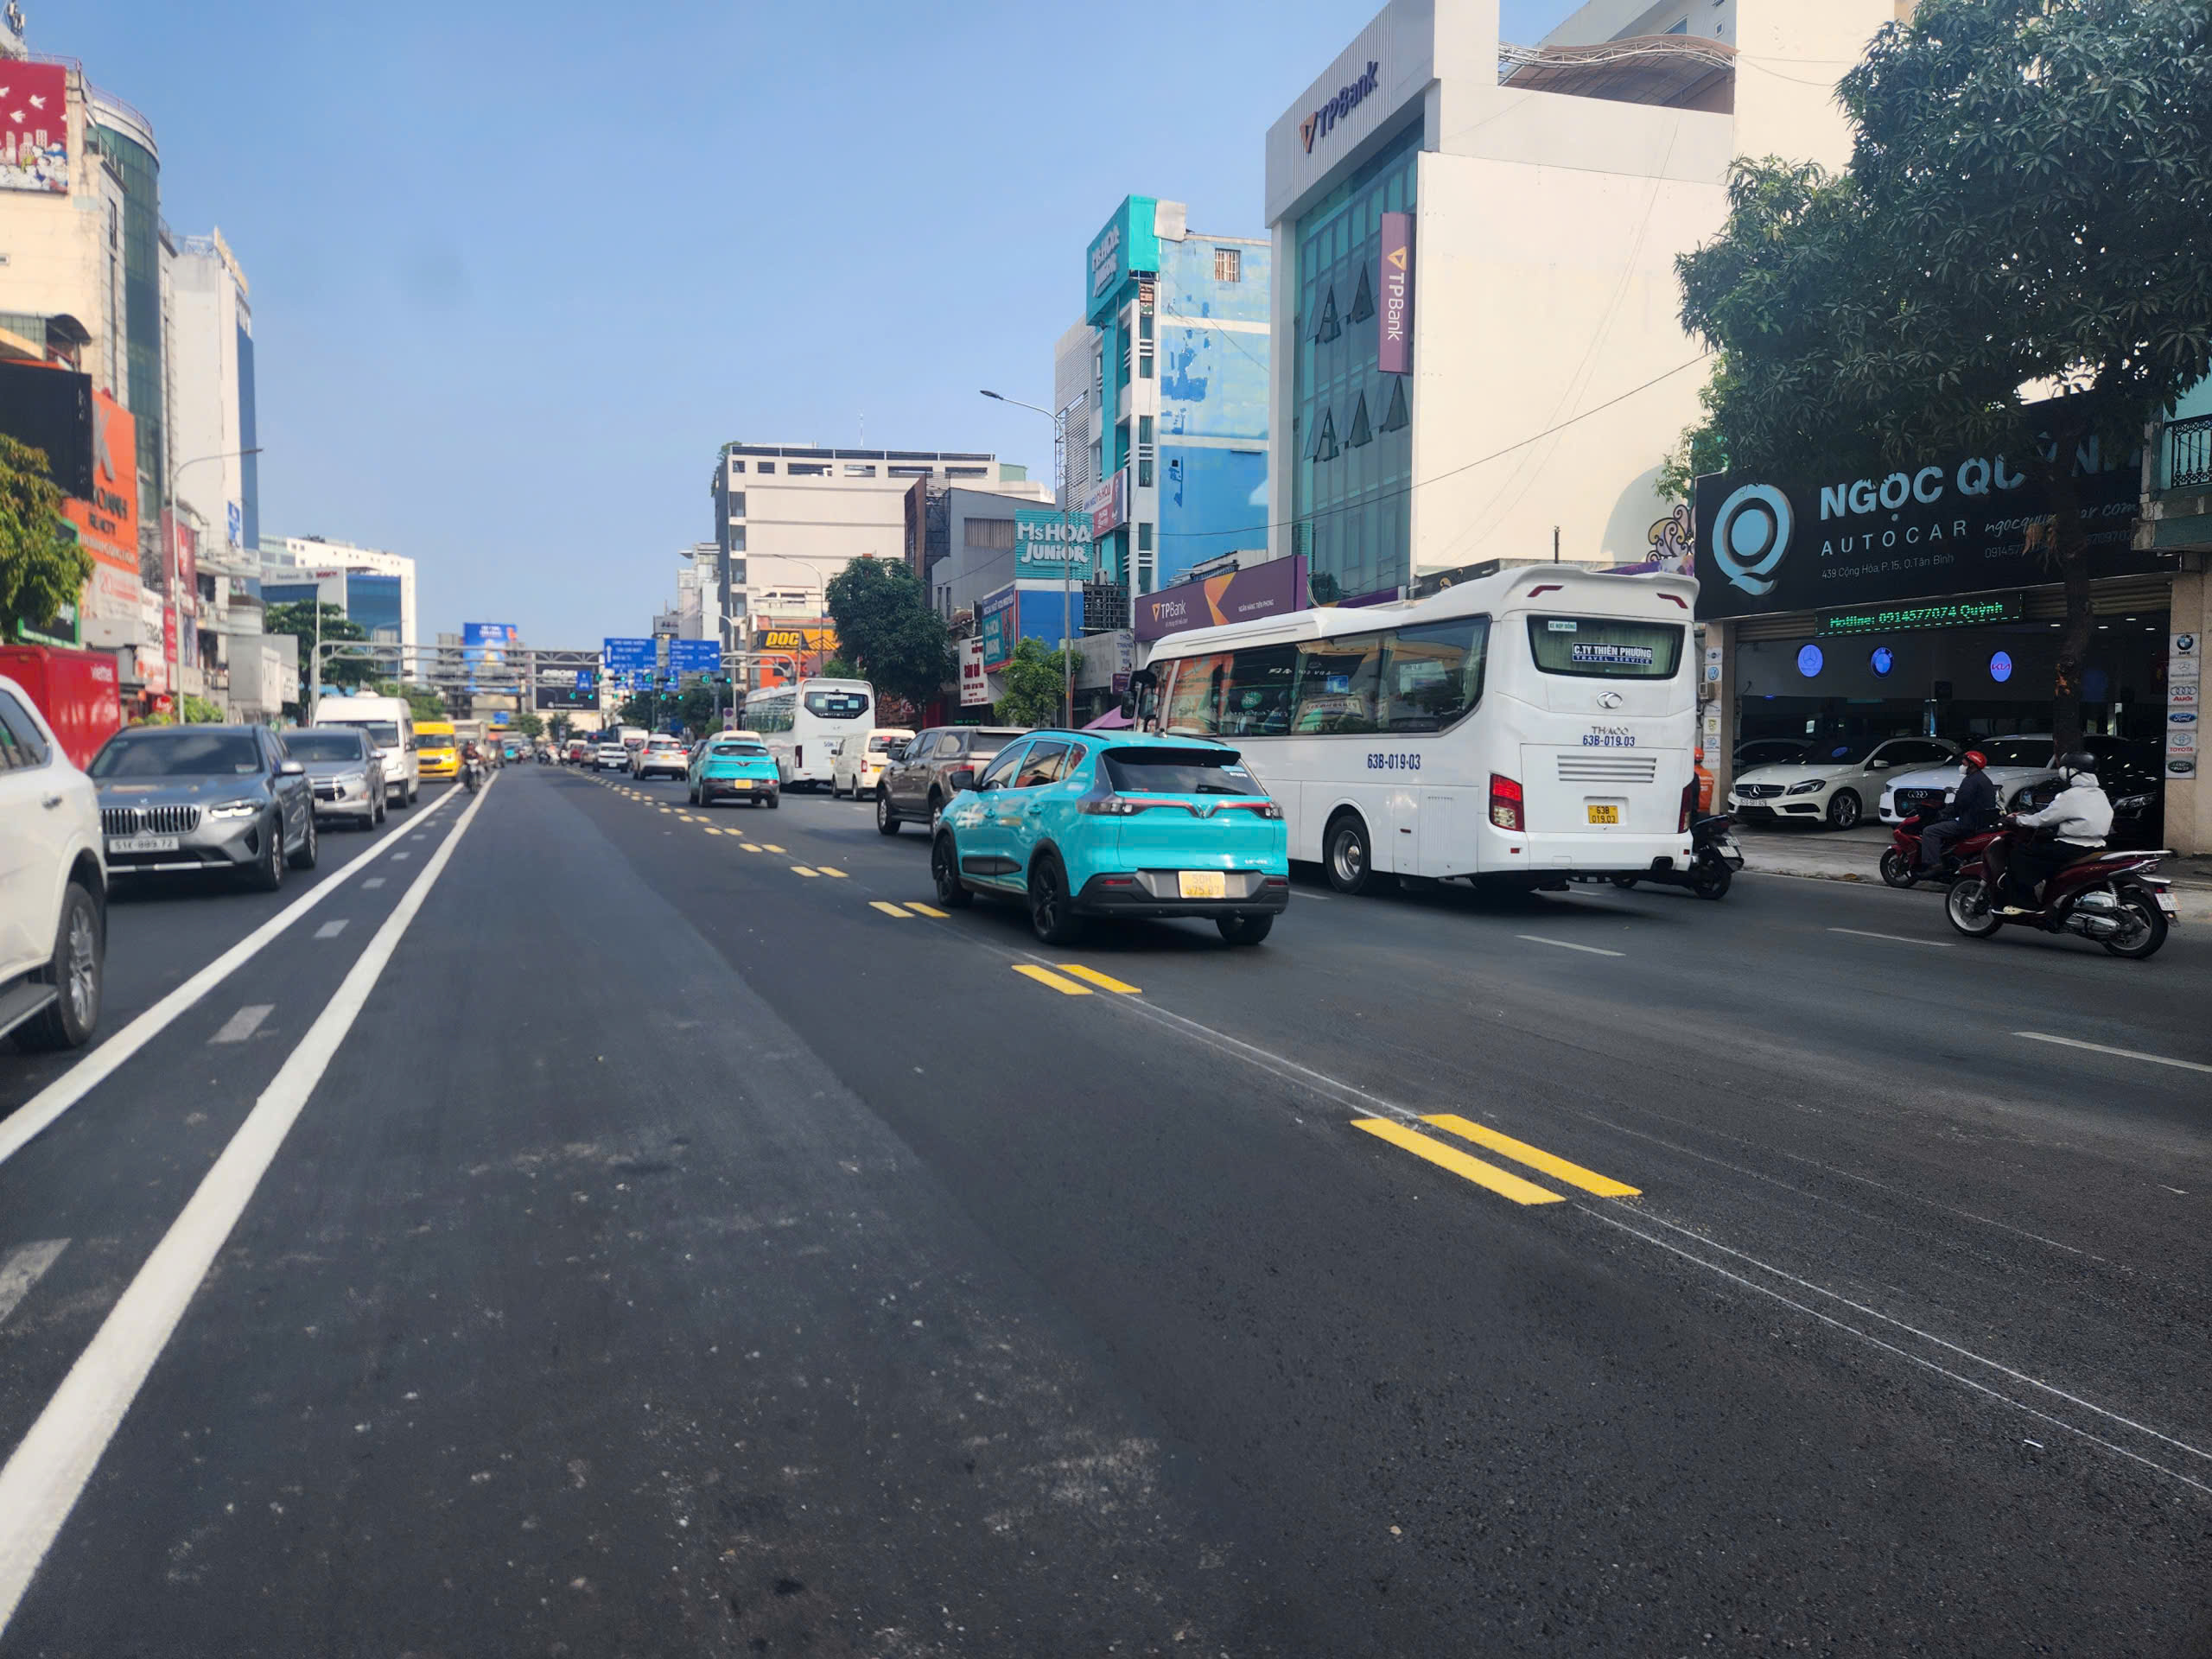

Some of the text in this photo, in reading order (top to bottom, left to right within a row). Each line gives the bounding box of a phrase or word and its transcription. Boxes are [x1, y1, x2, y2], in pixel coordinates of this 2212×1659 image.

[1319, 61, 1378, 137] TPBank
[1388, 272, 1404, 340] TPBank
[1821, 466, 1944, 522] NGỌC
[1822, 569, 1837, 579] 439
[1839, 567, 1859, 578] Cộng
[1933, 554, 1955, 565] Bình
[1161, 600, 1186, 619] TPBank
[1878, 607, 1957, 623] 0914577074
[1960, 601, 2003, 619] Quỳnh
[1574, 645, 1652, 658] C.TY THIÊN PHƯƠNG
[2173, 713, 2192, 722] Ford
[1592, 726, 1629, 735] THACO
[1582, 734, 1636, 747] 63B-019.03
[1367, 753, 1421, 770] 63B-019.03
[1592, 815, 1616, 823] 019.03
[1596, 806, 1610, 815] 63B
